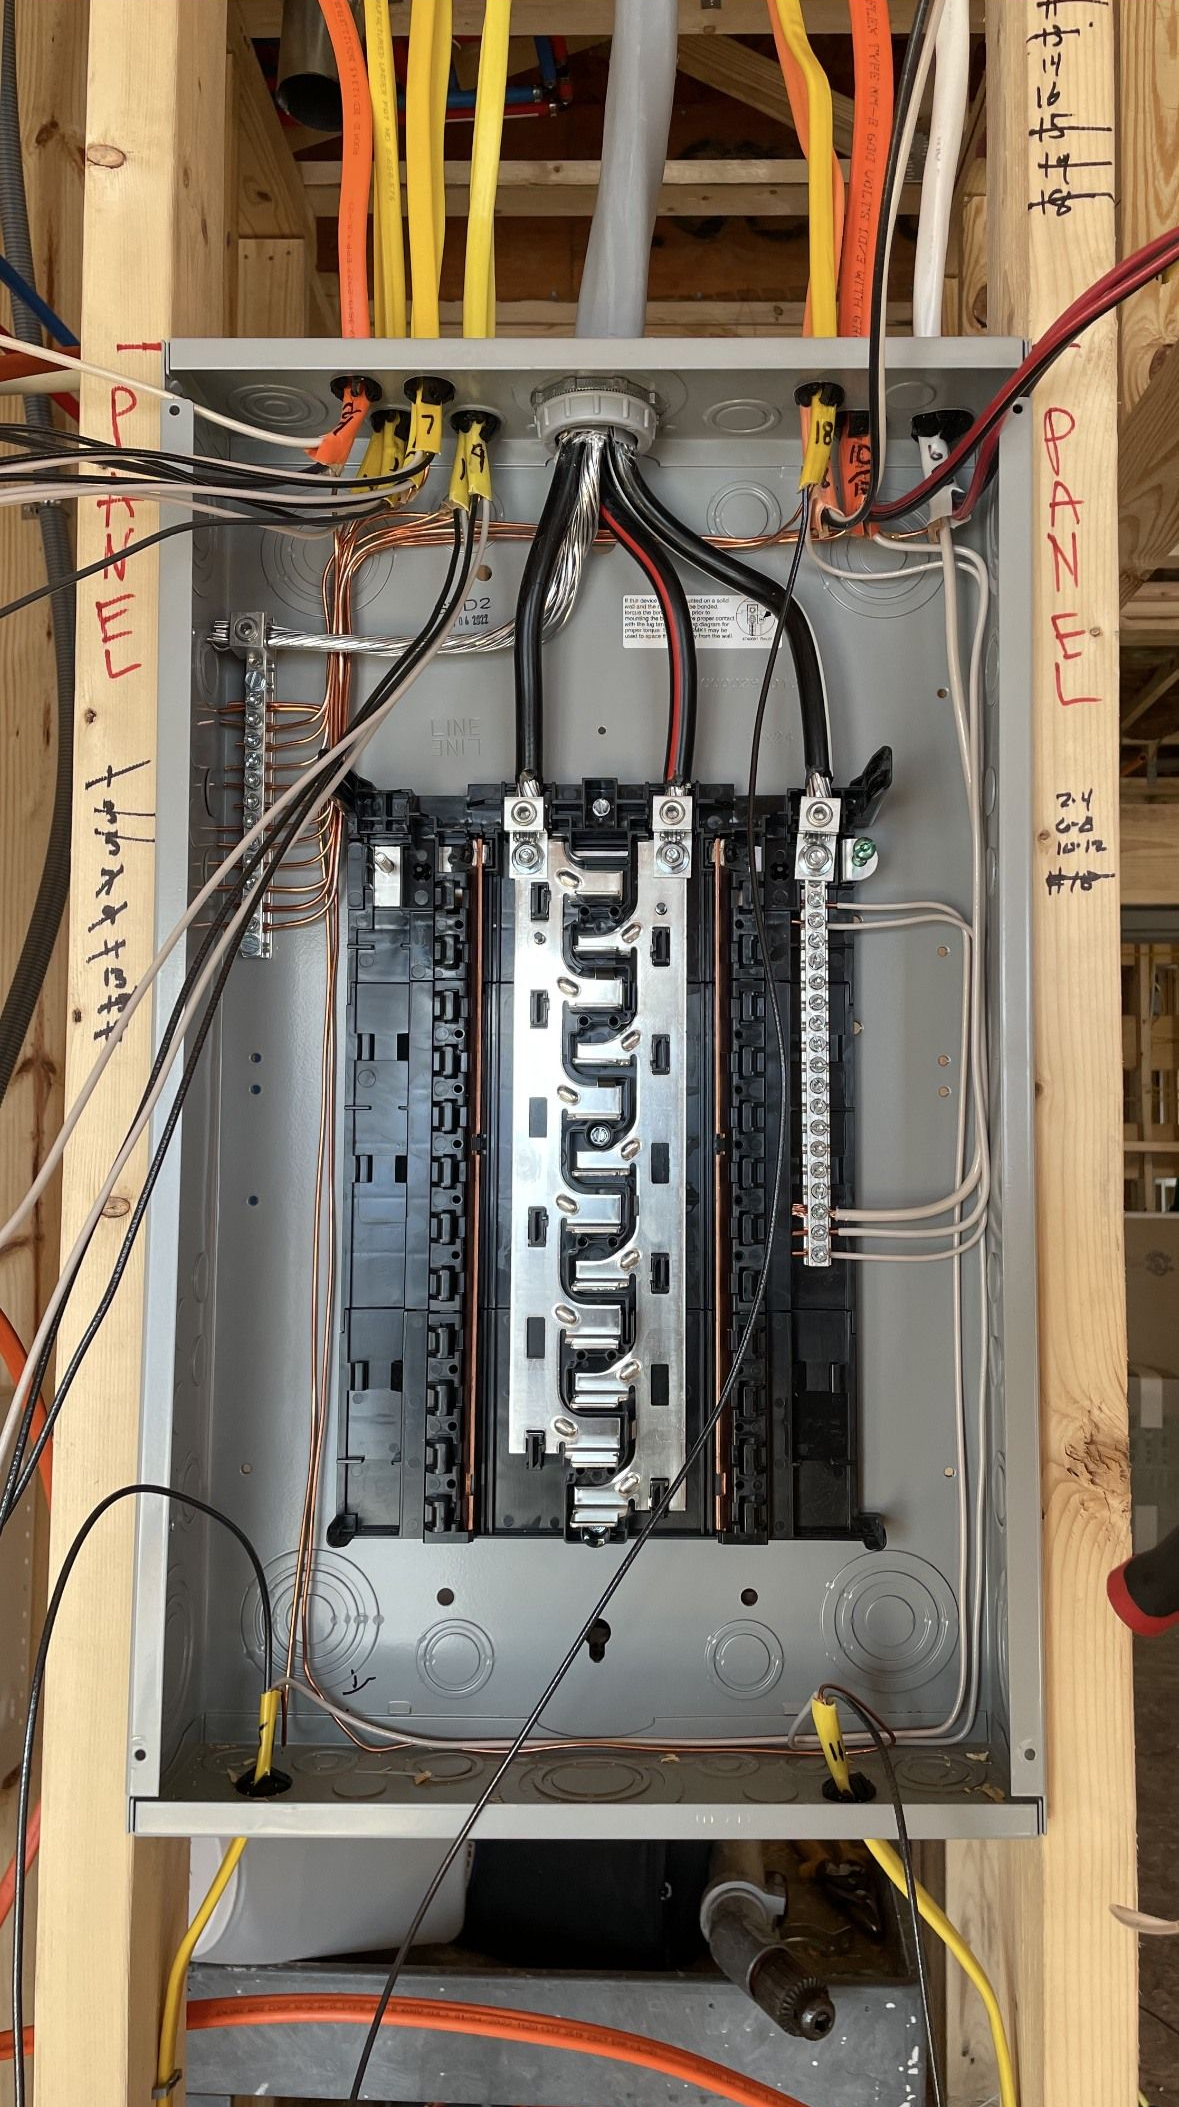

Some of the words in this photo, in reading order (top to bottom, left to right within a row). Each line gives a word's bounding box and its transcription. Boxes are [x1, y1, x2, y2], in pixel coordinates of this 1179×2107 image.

[868, 43, 881, 81] TYPE
[1043, 52, 1061, 77] 14
[868, 86, 880, 127] NM-B
[1037, 81, 1061, 109] 16
[865, 133, 876, 164] 600
[860, 169, 874, 221] VOLTS
[856, 227, 868, 264] 10/3
[853, 270, 865, 308] WITH
[421, 414, 434, 434] 7
[815, 420, 833, 446] 18
[470, 443, 485, 473] 9
[1044, 407, 1102, 706] PANEL
[431, 717, 481, 737] LINE
[104, 967, 127, 989] 13
